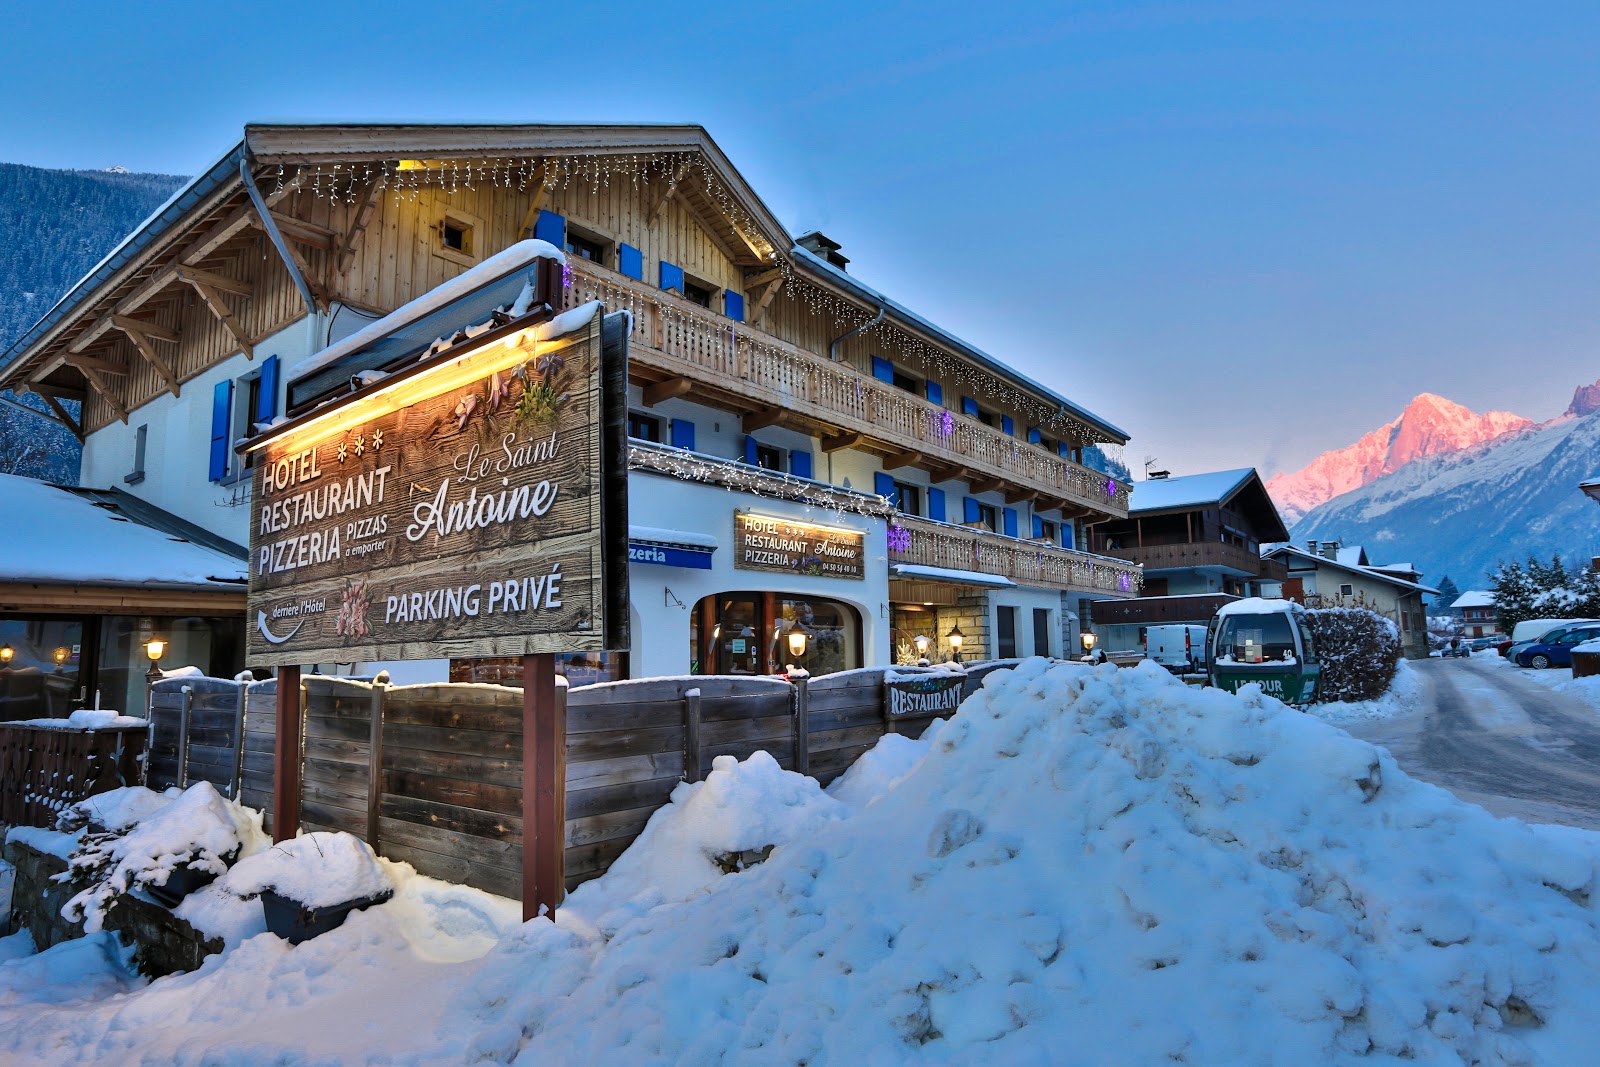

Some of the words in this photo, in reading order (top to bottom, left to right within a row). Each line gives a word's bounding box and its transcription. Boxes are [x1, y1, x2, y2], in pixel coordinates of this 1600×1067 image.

[454, 444, 494, 483] Le
[496, 431, 560, 472] Saint
[262, 446, 321, 496] HOTEL
[260, 466, 391, 536] RESTAURANT
[406, 478, 558, 541] Antoine
[346, 514, 388, 542] PIZZAS
[745, 518, 778, 534] HOTEL
[346, 546, 350, 556] à
[352, 540, 386, 557] emporter
[745, 534, 808, 553] RESTAURANT
[814, 540, 856, 558] Antoine
[829, 534, 840, 544] Le
[840, 535, 856, 546] Saint
[259, 526, 340, 576] PIZZERIA
[745, 550, 789, 566] PIZZERIA
[386, 584, 481, 624] PARKING
[488, 563, 562, 614] PRIVÉ
[272, 603, 299, 618] derrière
[300, 598, 326, 614] l'Hôtel
[1283, 649, 1292, 660] 40
[1250, 680, 1283, 692] OUR
[891, 682, 962, 714] RESTAURANT
